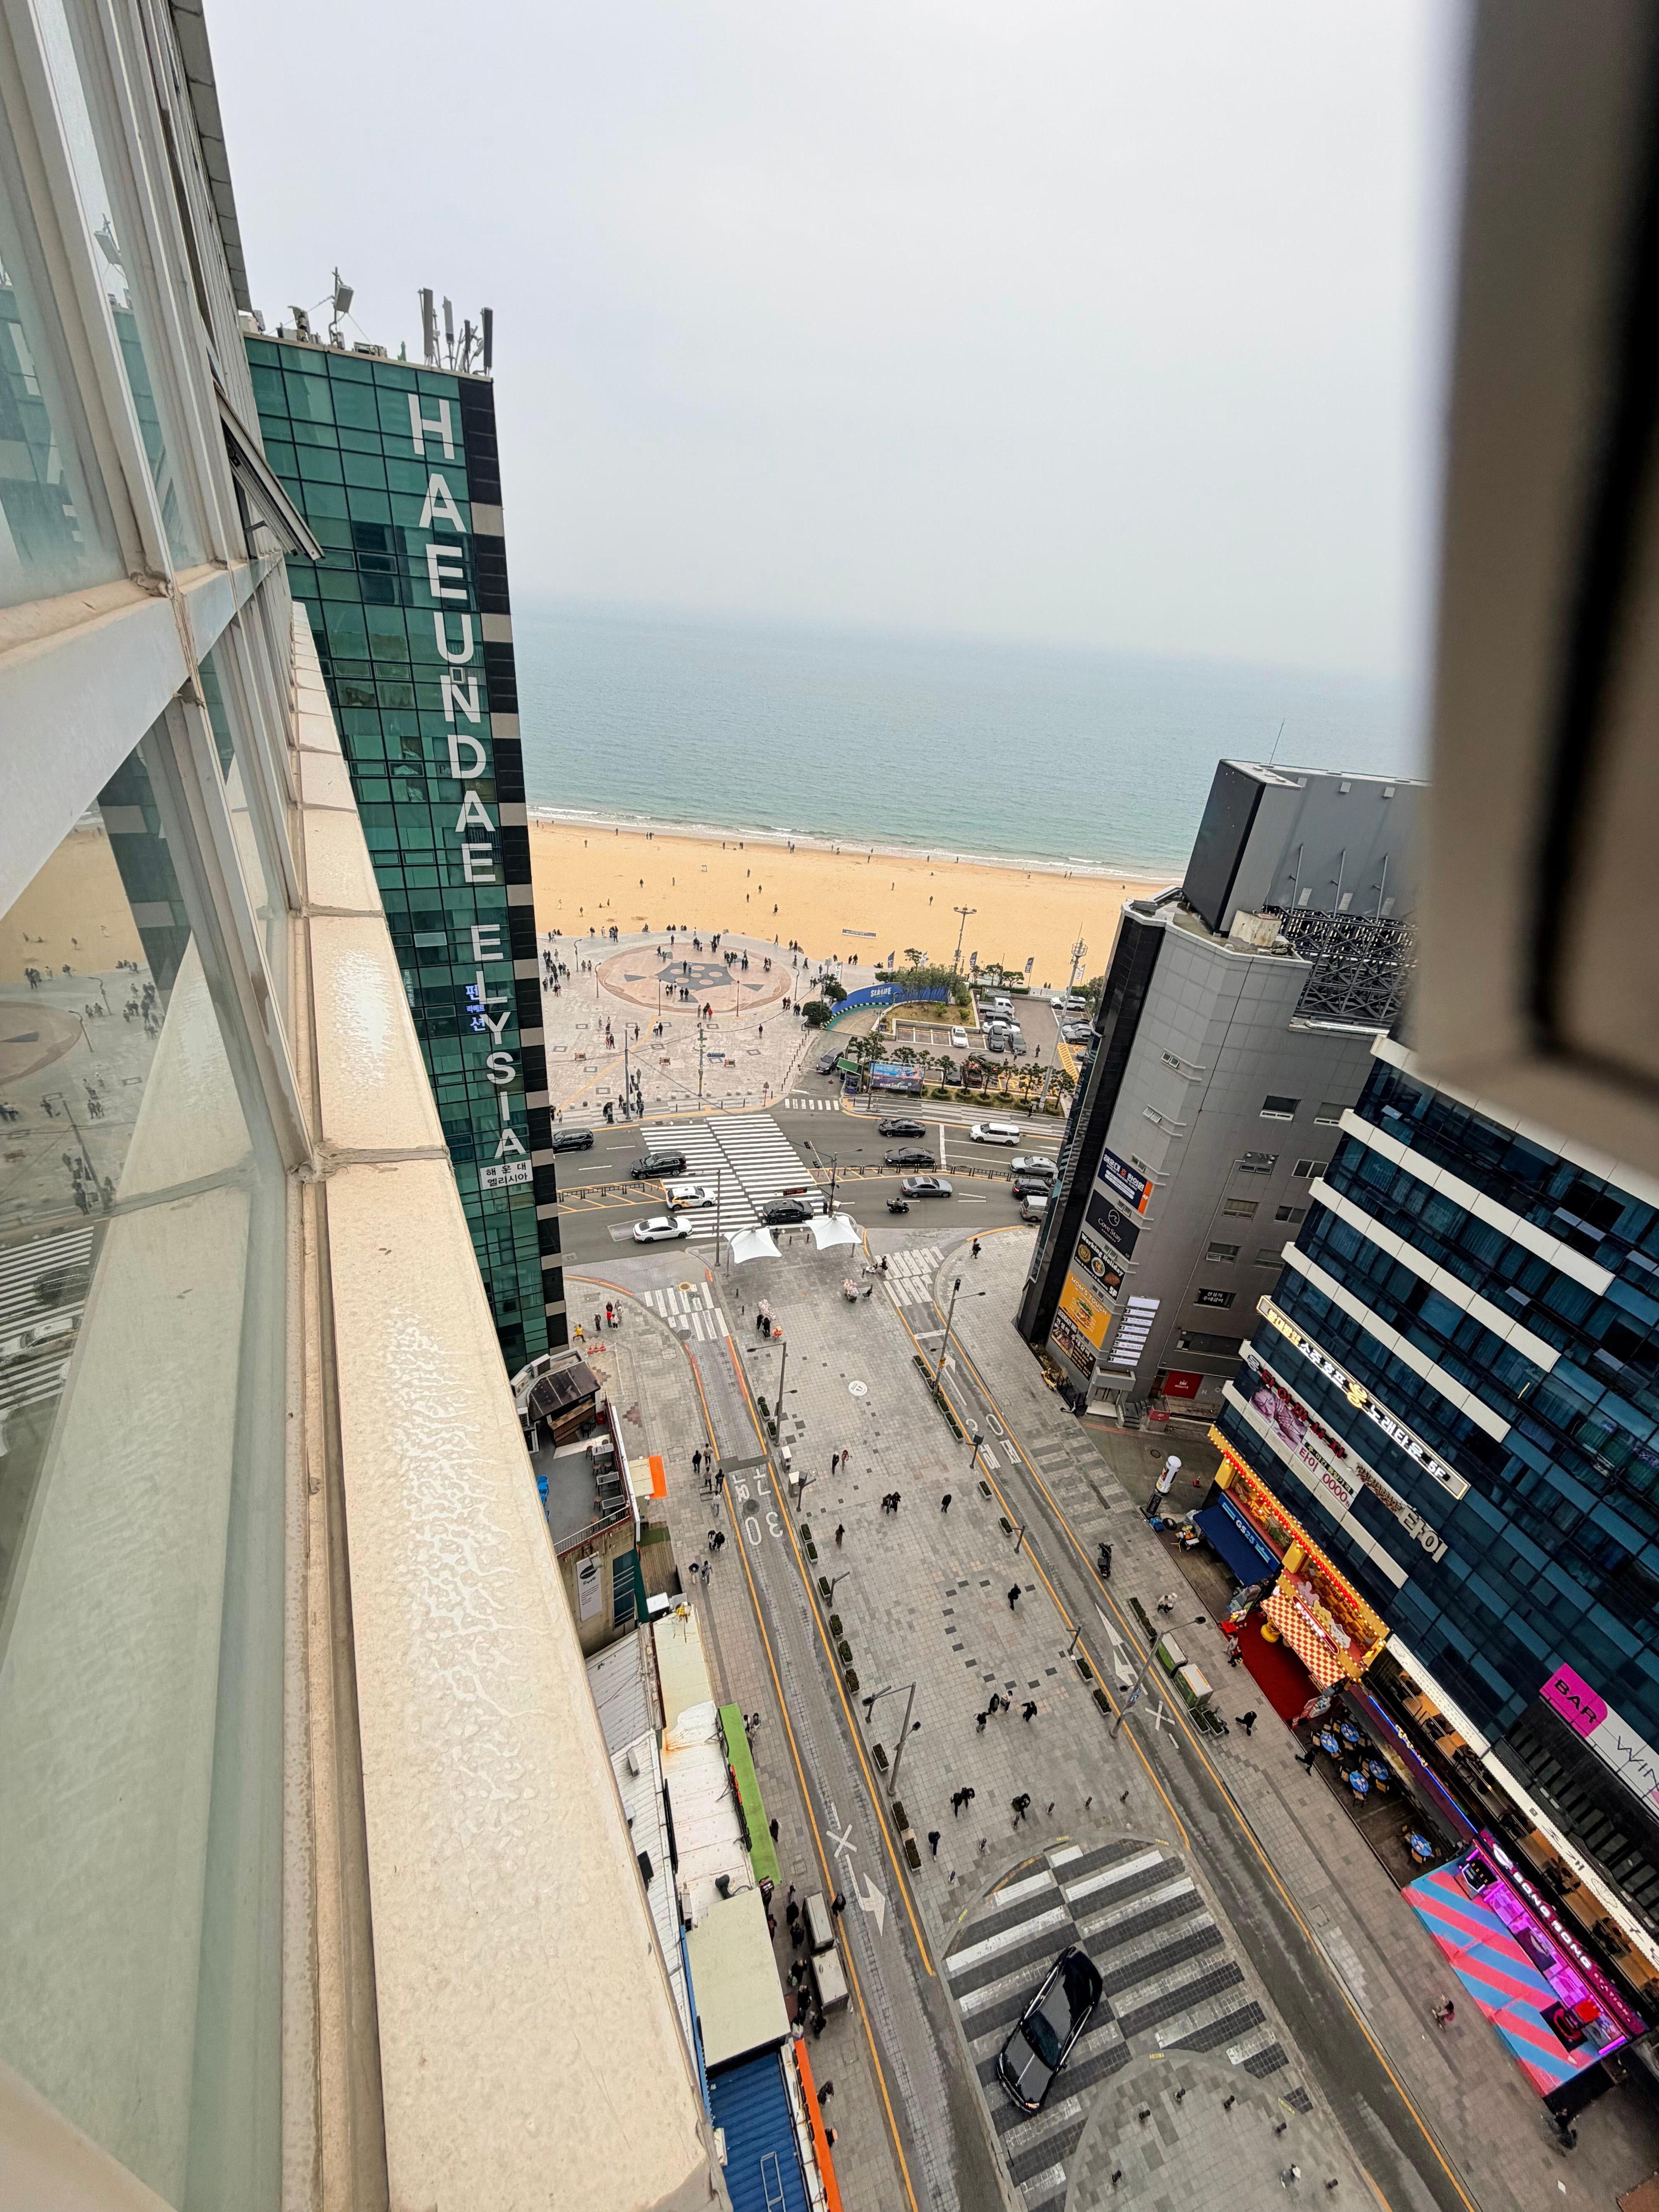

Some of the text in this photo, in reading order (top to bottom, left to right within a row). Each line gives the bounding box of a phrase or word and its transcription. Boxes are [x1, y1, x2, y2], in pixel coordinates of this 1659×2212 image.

[408, 394, 495, 882] HAEUNDAE
[471, 924, 527, 1159] ELYSIA
[487, 1172, 528, 1187] 엘리시아
[1102, 1154, 1121, 1172] 해운대
[1126, 1172, 1145, 1192] 한의원
[1098, 1218, 1121, 1242] Cove Stay
[1081, 1233, 1124, 1276] Working Holiday
[1070, 1276, 1089, 1296] MOM'S
[1089, 1293, 1108, 1315] TOUCH
[1259, 1369, 1345, 1459] 타이마사지
[1299, 1340, 1323, 1365] 소주
[1321, 1360, 1347, 1387] 호프
[1366, 1404, 1424, 1460] 노래타운
[1427, 1460, 1446, 1479] 5F
[1298, 1446, 1319, 1472] 타이
[1235, 1518, 1255, 1544] GS25
[1398, 1505, 1448, 1563] 타이
[1554, 1678, 1598, 1724] BAR
[1513, 1871, 1551, 1918] BONG
